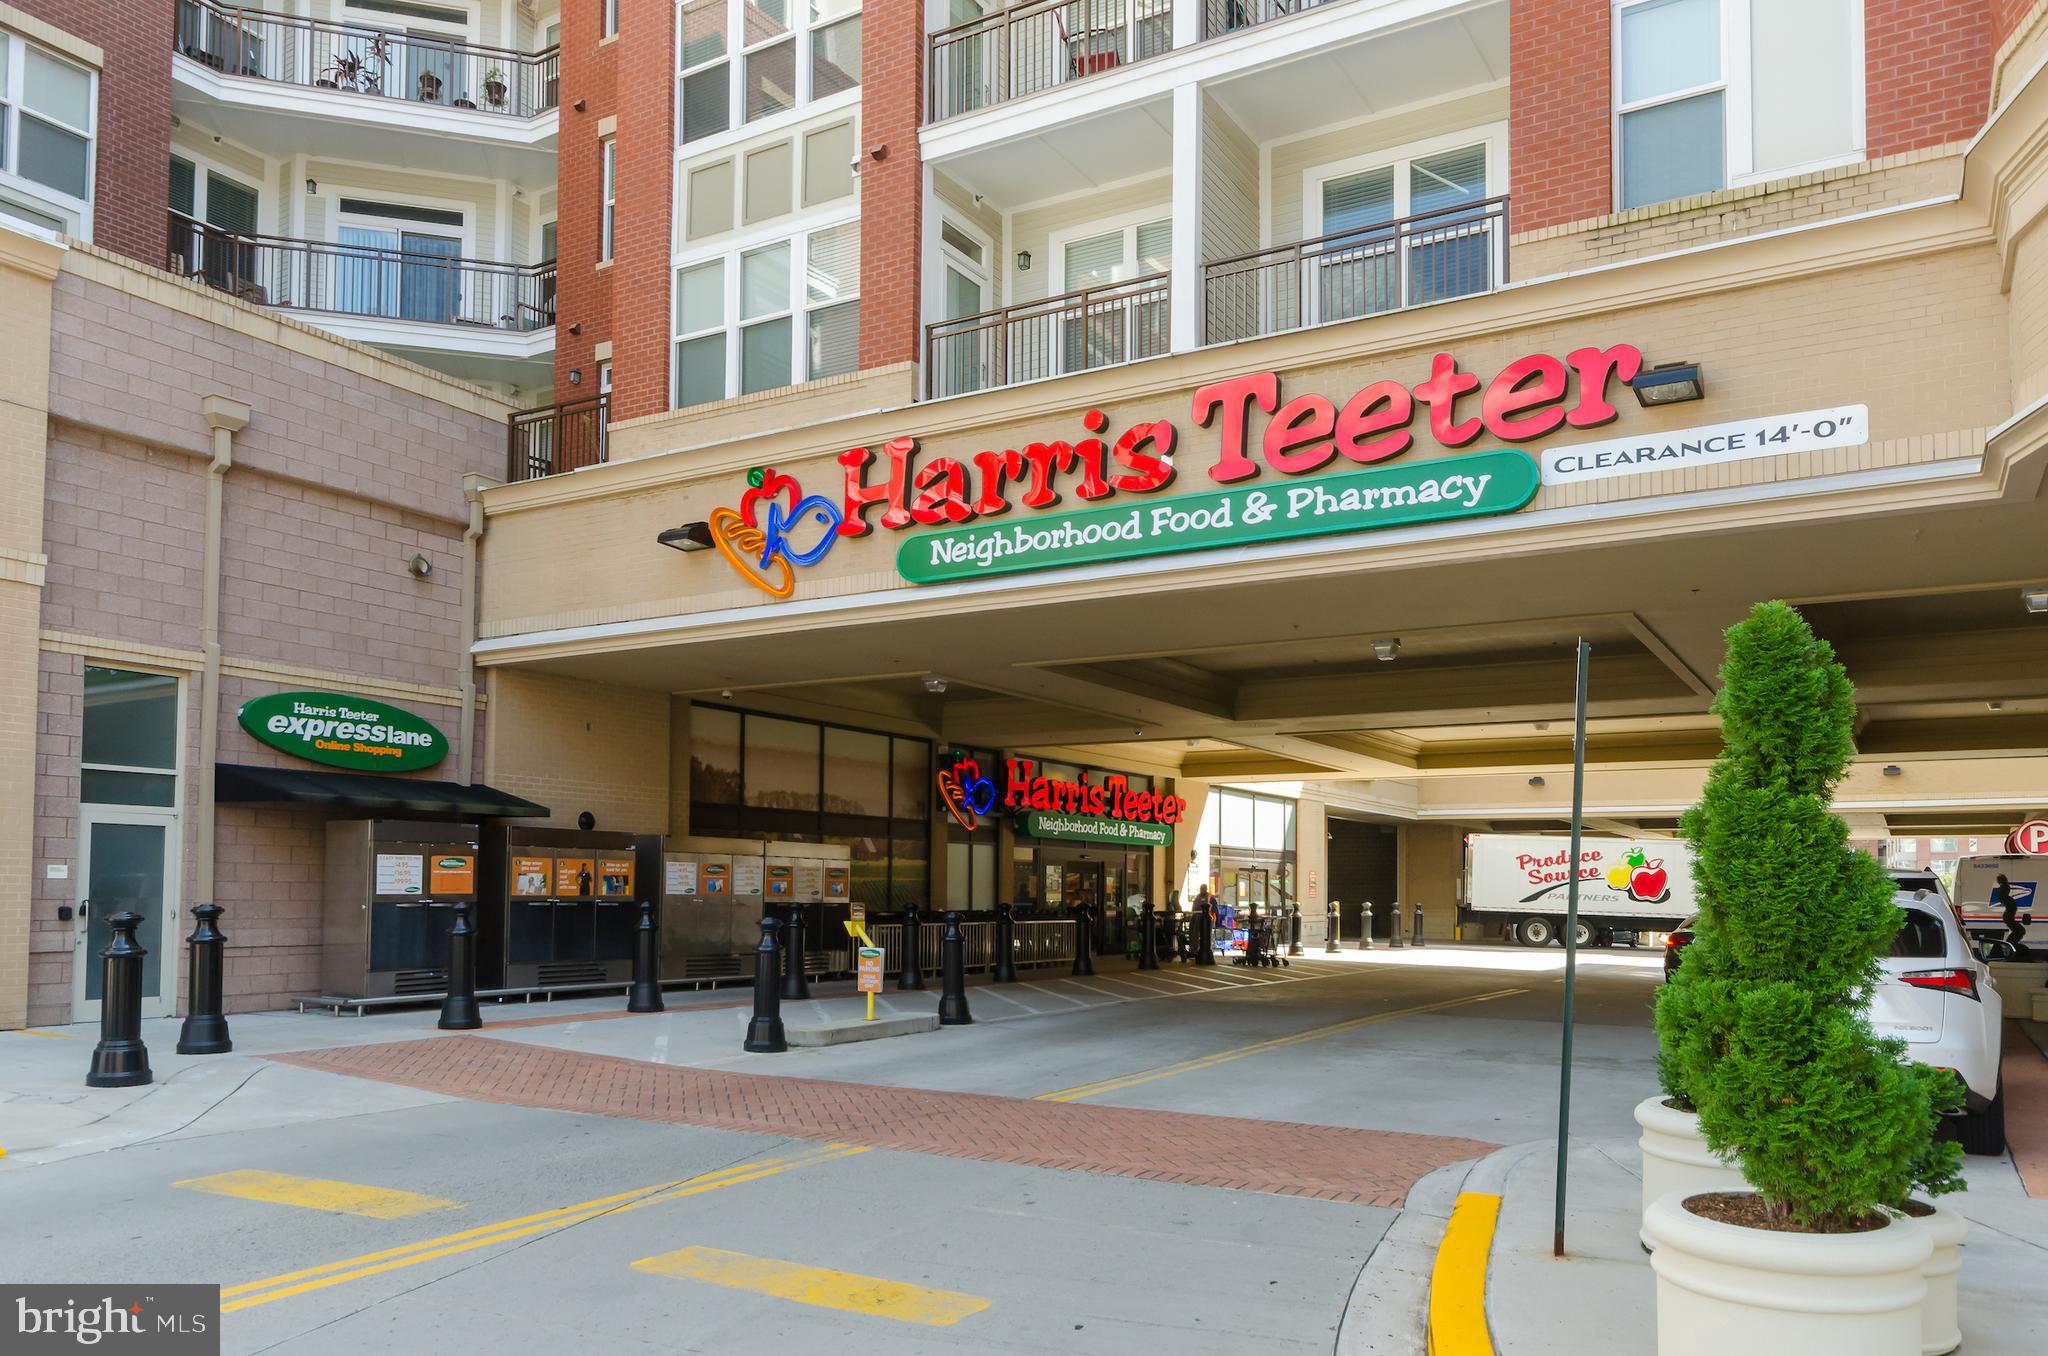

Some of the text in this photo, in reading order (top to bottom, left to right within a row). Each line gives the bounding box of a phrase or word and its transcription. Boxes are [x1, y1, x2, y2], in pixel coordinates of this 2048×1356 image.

[837, 343, 1644, 537] Harris Teeter
[1554, 434, 1747, 475] CLEARANCE
[930, 473, 1492, 568] Neighborhood Food & Pharmacy
[293, 702, 380, 722] Harris Teeter
[267, 714, 433, 747] expresslane
[314, 739, 403, 758] Online Shopping
[1004, 759, 1187, 824] Harris Teeter
[1038, 816, 1166, 842] Neighborhood Food & Pharmacy
[2031, 826, 2048, 852] P
[1528, 867, 1601, 884] Souce
[1547, 892, 1620, 902] PATNERS
